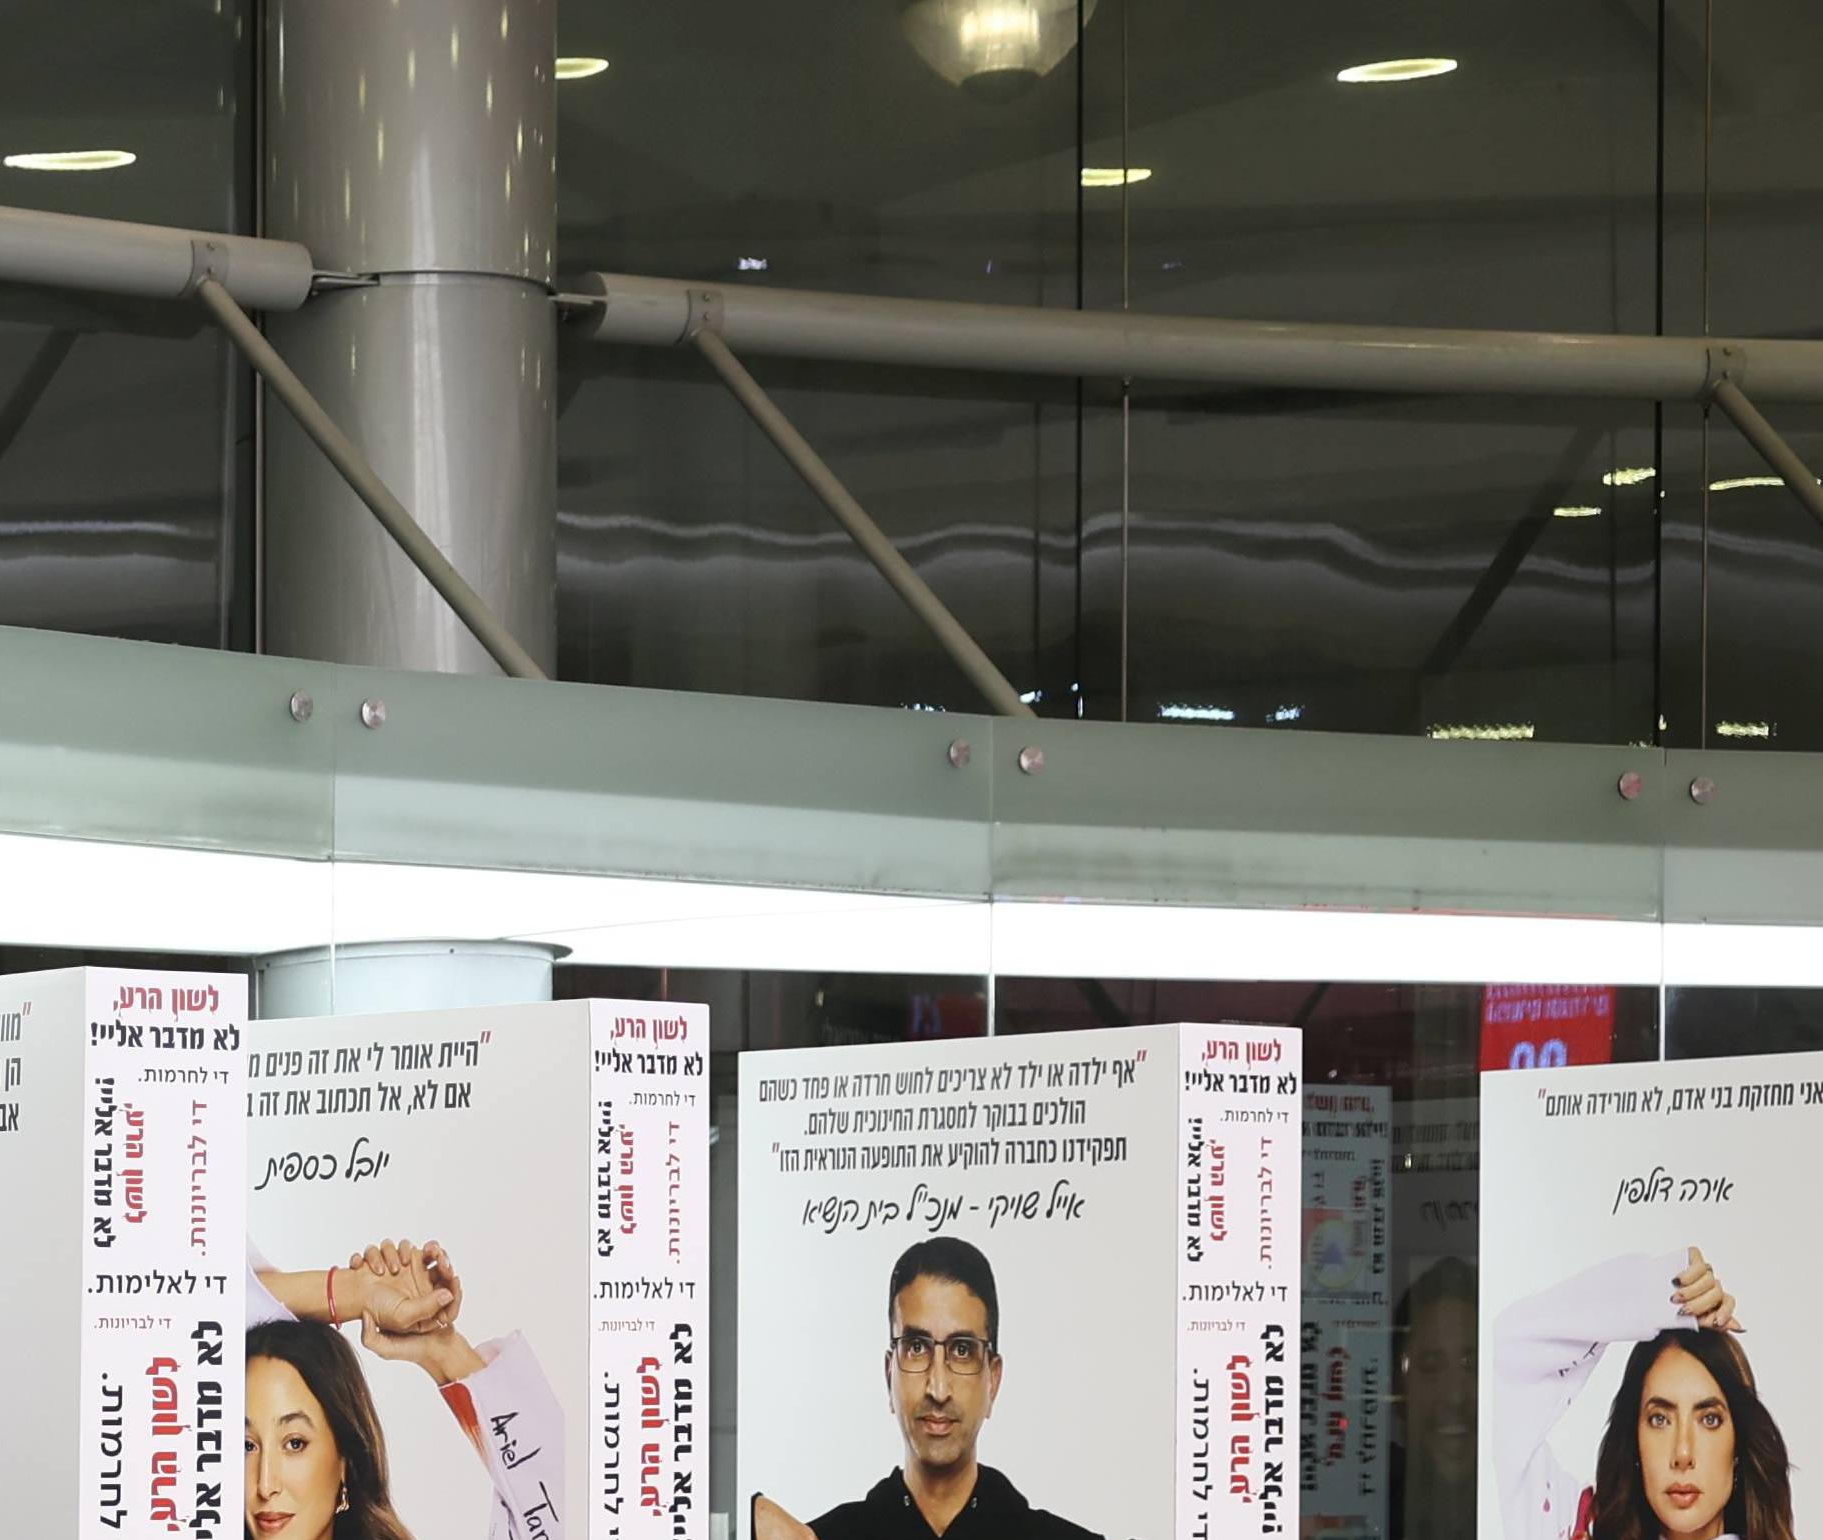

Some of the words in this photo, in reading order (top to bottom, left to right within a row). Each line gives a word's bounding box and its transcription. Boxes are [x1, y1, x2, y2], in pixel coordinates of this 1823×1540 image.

[171, 983, 219, 1022] לשון
[265, 1050, 303, 1078] פנים
[307, 1049, 330, 1075] זה
[333, 1047, 362, 1074] את
[366, 1041, 385, 1072] לי
[390, 1043, 434, 1071] אומר
[852, 1072, 891, 1098] חרדה
[895, 1066, 934, 1096] לחוש
[937, 1067, 988, 1094] צריכים
[990, 1061, 1013, 1091] לא
[1017, 1060, 1043, 1089] ילד
[1046, 1063, 1065, 1088] או
[1068, 1056, 1108, 1087] ילדה
[1228, 1073, 1271, 1094] מדבר
[1276, 1071, 1297, 1095] לא
[316, 1087, 371, 1115] תכתוב
[377, 1081, 402, 1112] אל
[444, 1081, 471, 1109] אם
[759, 1078, 798, 1103] כשהם
[801, 1076, 830, 1100] פחד
[833, 1075, 849, 1099] או
[1641, 1085, 1664, 1113] לא
[1710, 1086, 1733, 1109] בני
[1737, 1082, 1795, 1112] מחזקת
[259, 1091, 280, 1117] זה
[284, 1089, 311, 1116] את
[917, 1100, 978, 1131] למסגרת
[1032, 1096, 1086, 1126] הולכים
[1586, 1091, 1638, 1115] מורידה
[852, 1107, 914, 1134] החינוכית
[982, 1102, 1028, 1133] בבוקר
[344, 1136, 390, 1183] יובל
[803, 1146, 857, 1172] הנוראית
[861, 1144, 917, 1170] התופעה
[920, 1143, 943, 1168] את
[947, 1137, 1000, 1171] להוקיע
[1005, 1138, 1057, 1165] כחברה
[1062, 1136, 1127, 1167] תפקידנו
[254, 1151, 338, 1191] כספית
